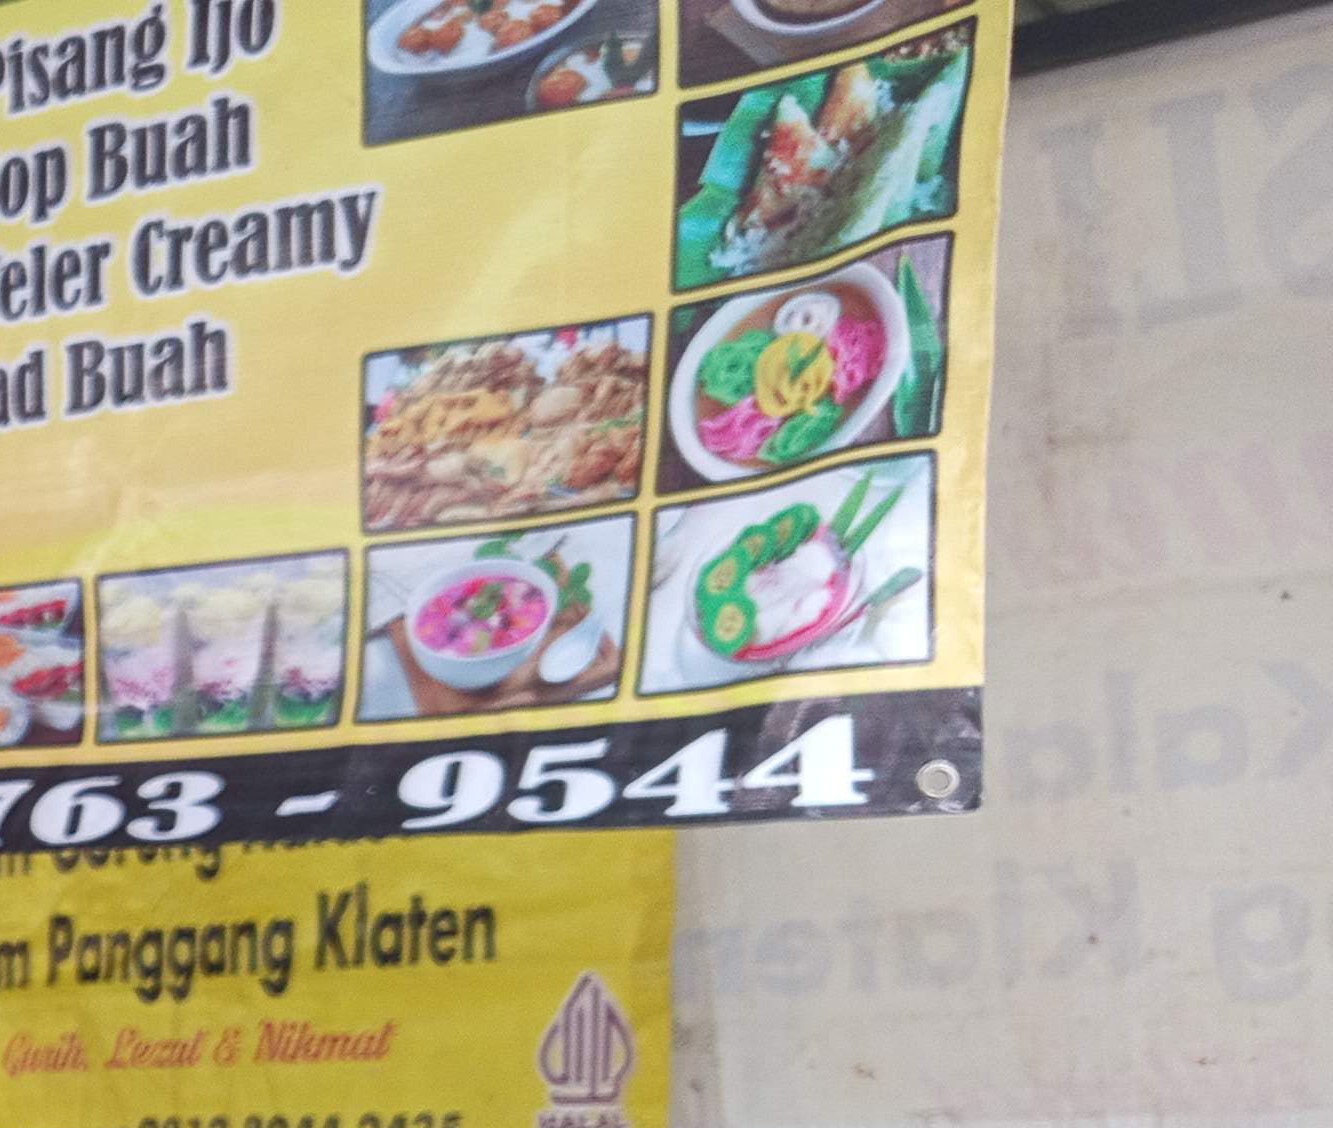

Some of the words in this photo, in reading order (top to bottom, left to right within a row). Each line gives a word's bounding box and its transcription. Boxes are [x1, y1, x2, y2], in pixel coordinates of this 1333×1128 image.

[88, 97, 251, 201] Buah
[134, 191, 377, 297] Creamy
[65, 321, 228, 416] Buah
[399, 714, 874, 831] 9544
[47, 912, 294, 1004] Panggang
[317, 882, 497, 972] Klaten
